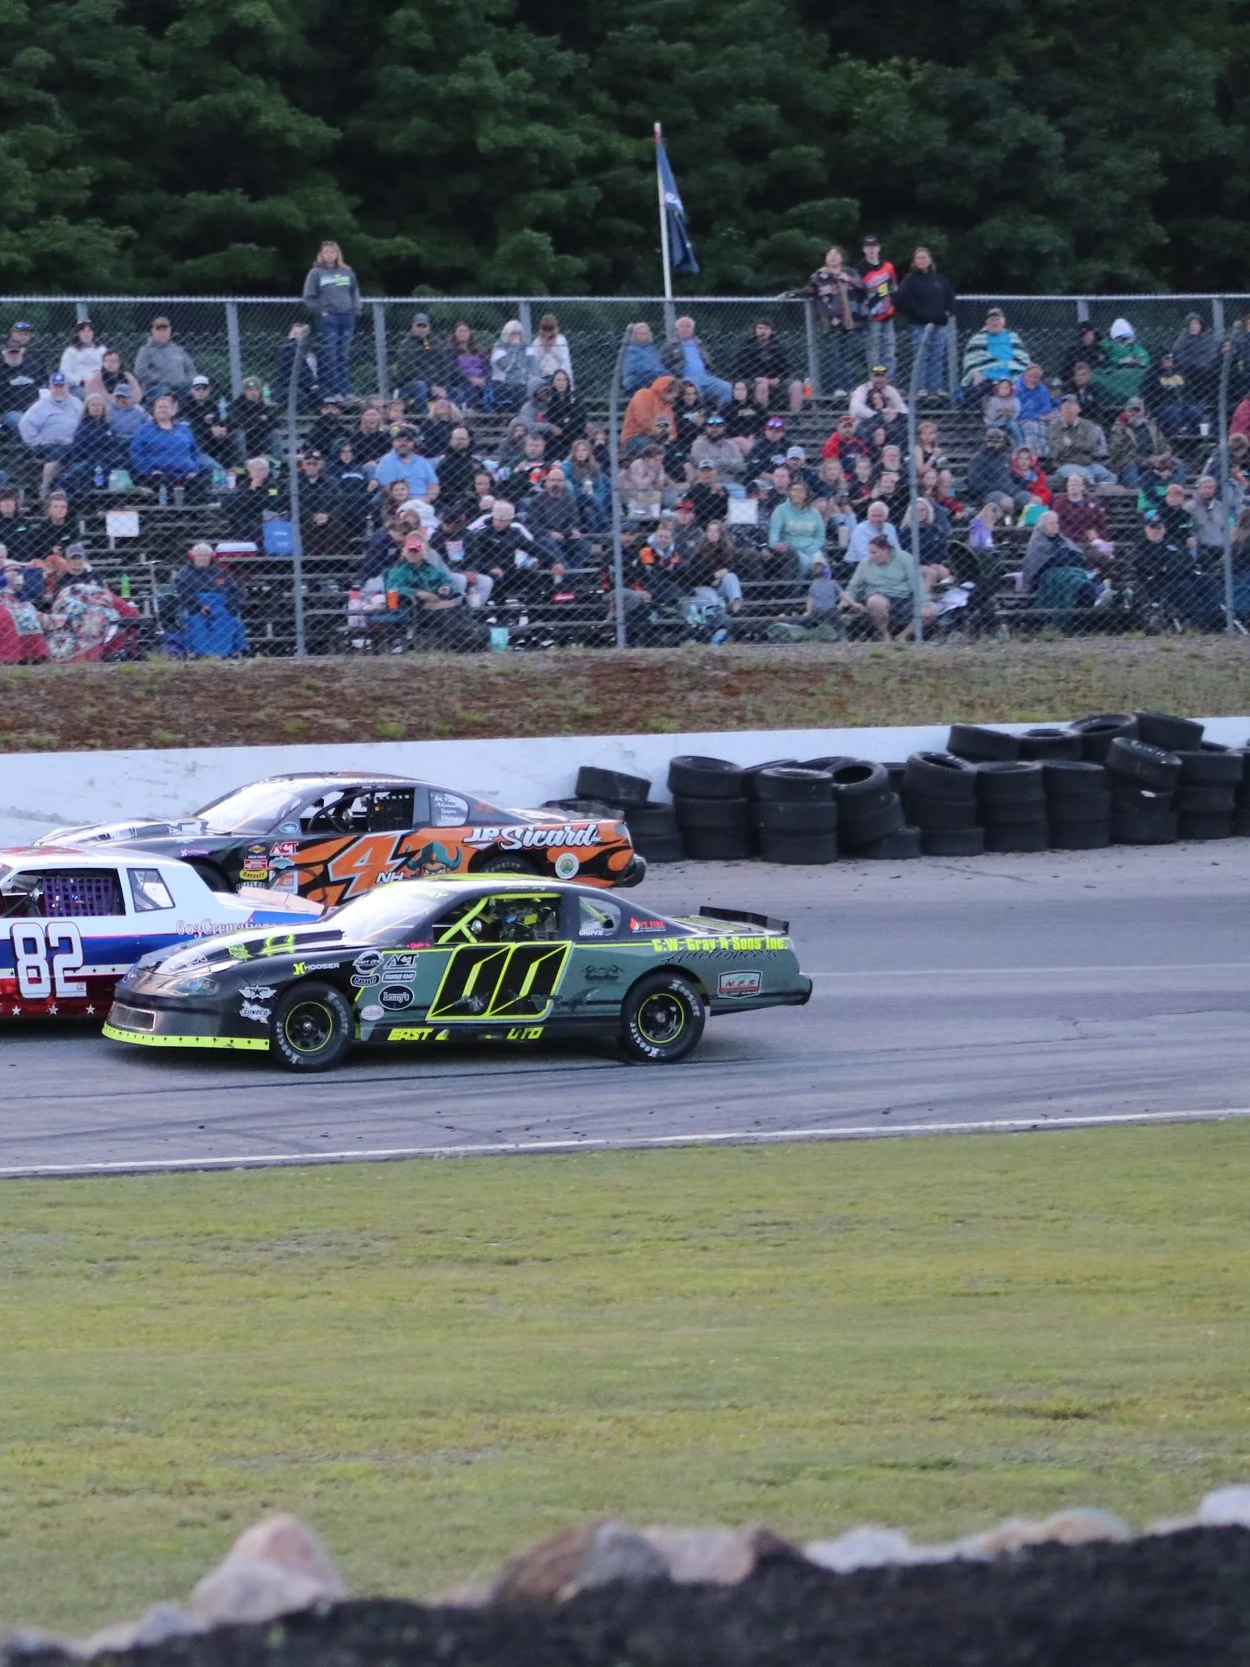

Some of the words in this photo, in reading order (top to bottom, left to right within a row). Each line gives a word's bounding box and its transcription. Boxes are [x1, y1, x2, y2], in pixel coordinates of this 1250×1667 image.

[500, 823, 597, 850] Sicard
[270, 842, 299, 856] ACT
[327, 830, 415, 901] 4
[686, 937, 716, 953] Gray
[731, 936, 762, 950] Sons
[10, 922, 87, 999] 82
[304, 962, 340, 970] HOOSIER
[385, 953, 418, 969] ACT
[387, 1028, 434, 1040] EAST
